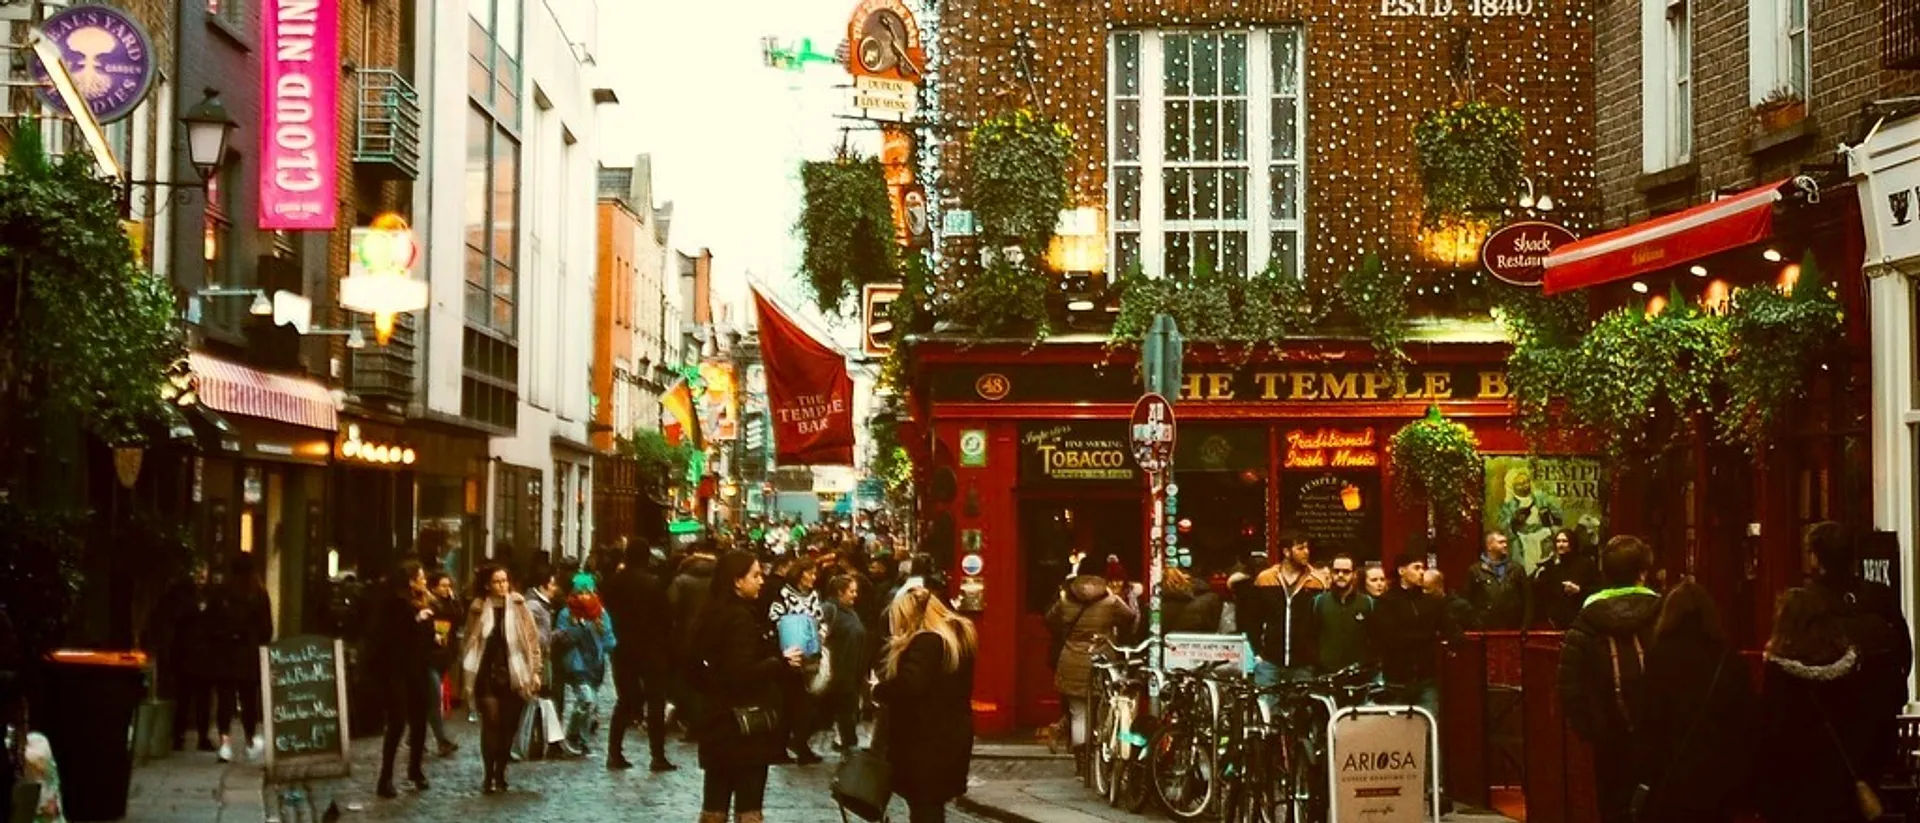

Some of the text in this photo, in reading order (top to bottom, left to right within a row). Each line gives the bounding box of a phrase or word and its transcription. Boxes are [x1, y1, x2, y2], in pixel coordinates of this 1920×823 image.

[1471, 0, 1533, 16] 1840
[45, 12, 141, 60] EAL'S YARD
[276, 73, 322, 192] CLOUD
[982, 377, 1003, 393] 48
[1177, 372, 1236, 400] HE
[1254, 372, 1452, 399] TEMPLE
[797, 393, 825, 407] THE
[776, 398, 845, 424] TEMPLE
[797, 416, 830, 435] BAR
[1286, 430, 1373, 450] Traditional
[1037, 445, 1124, 475] TOBACCO
[1284, 449, 1376, 468] Irish Music
[1555, 481, 1598, 499] BAR
[1342, 751, 1417, 772] ARIOSA
